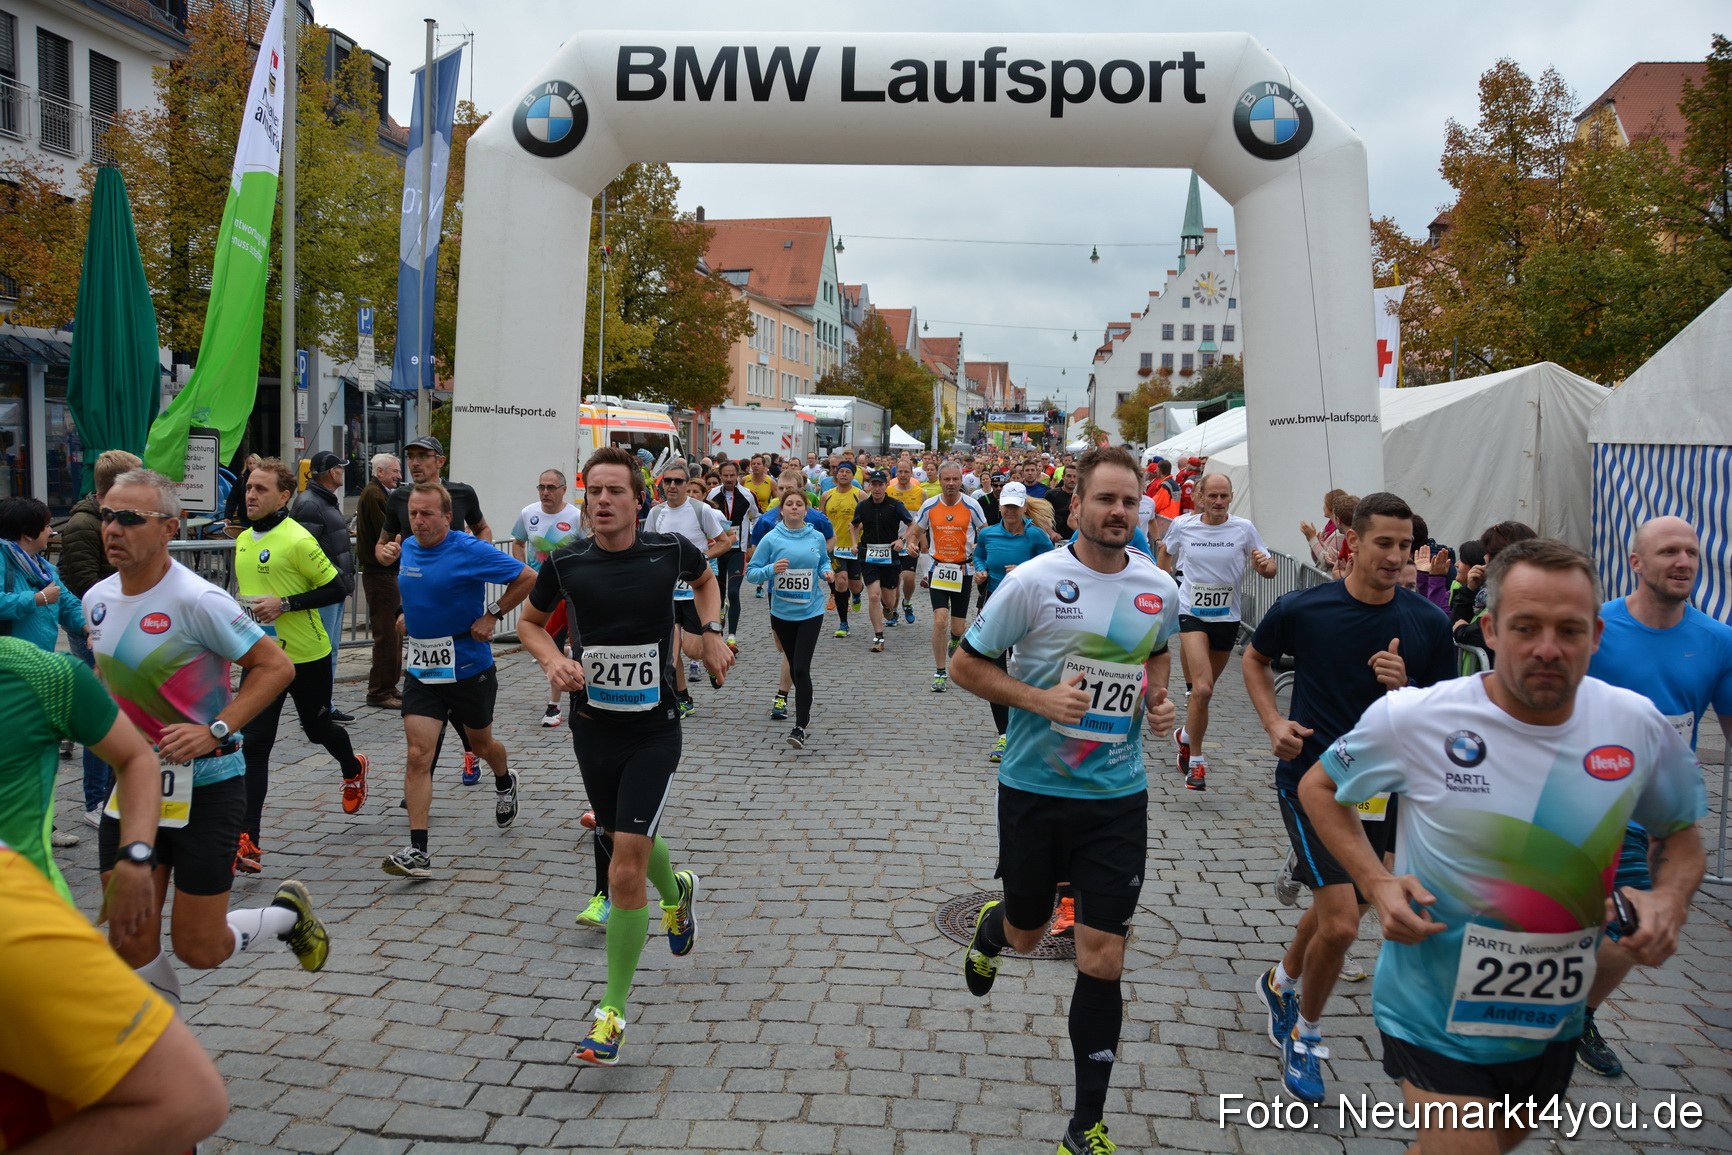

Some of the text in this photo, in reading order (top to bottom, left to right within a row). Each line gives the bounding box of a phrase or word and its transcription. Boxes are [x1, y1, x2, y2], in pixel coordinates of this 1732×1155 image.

[616, 46, 1206, 118] BMW Laufsport
[523, 82, 583, 107] BMW
[1240, 83, 1305, 109] BMW
[299, 355, 306, 384] P
[322, 402, 328, 415] 3
[1269, 411, 1379, 427] www.bmw-laufsport.de
[187, 445, 215, 453] Richtung
[868, 548, 889, 558] 2750
[938, 569, 958, 581] 540
[778, 577, 810, 590] 2659
[1194, 592, 1230, 607] 2507
[143, 618, 169, 628] Hervis
[413, 648, 451, 667] 2448
[610, 652, 647, 660] Neumarkt
[591, 661, 653, 687] 2476
[1066, 661, 1135, 680] PARTL Neumarkt
[600, 691, 646, 704] Christoph
[1590, 754, 1631, 771] Hervis
[1445, 772, 1491, 786] PARTL
[1445, 783, 1491, 794] Neumarkt
[1355, 802, 1370, 810] as
[1467, 935, 1576, 956] PARTL Neumarkt
[1471, 956, 1584, 999] 2225
[1482, 1005, 1558, 1025] Andreas
